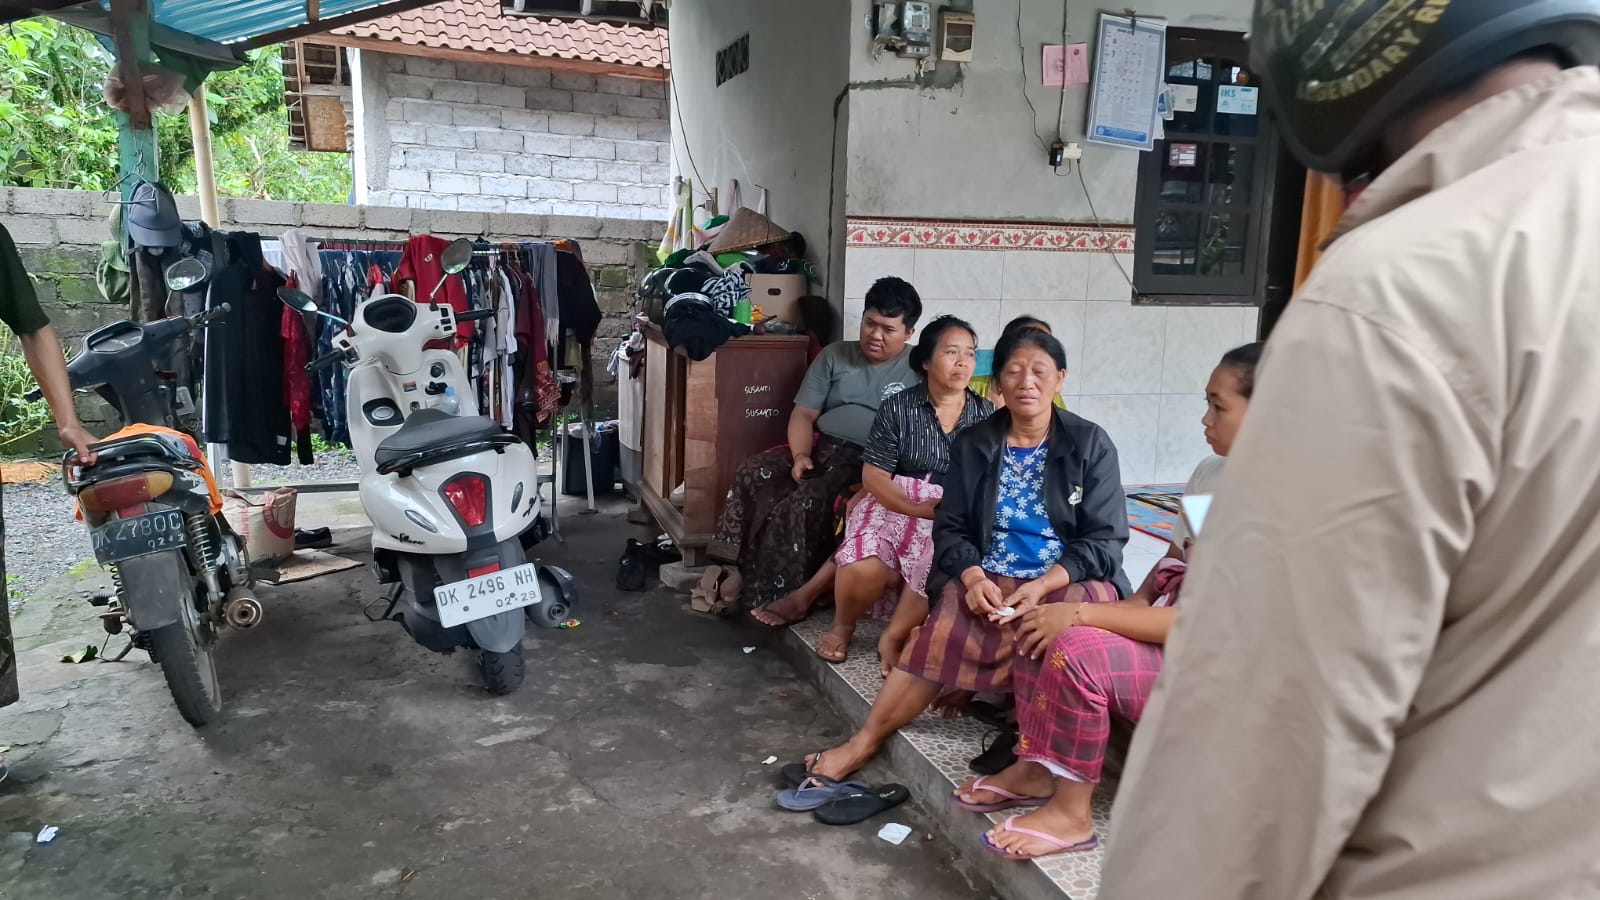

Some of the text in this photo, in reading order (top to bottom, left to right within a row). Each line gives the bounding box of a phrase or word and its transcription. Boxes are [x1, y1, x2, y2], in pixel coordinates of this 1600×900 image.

[1220, 88, 1236, 98] IKS
[744, 385, 771, 395] SUSANTI
[745, 408, 780, 419] SUSANTO
[91, 525, 111, 550] DK
[438, 567, 534, 606] DK 2496 NH
